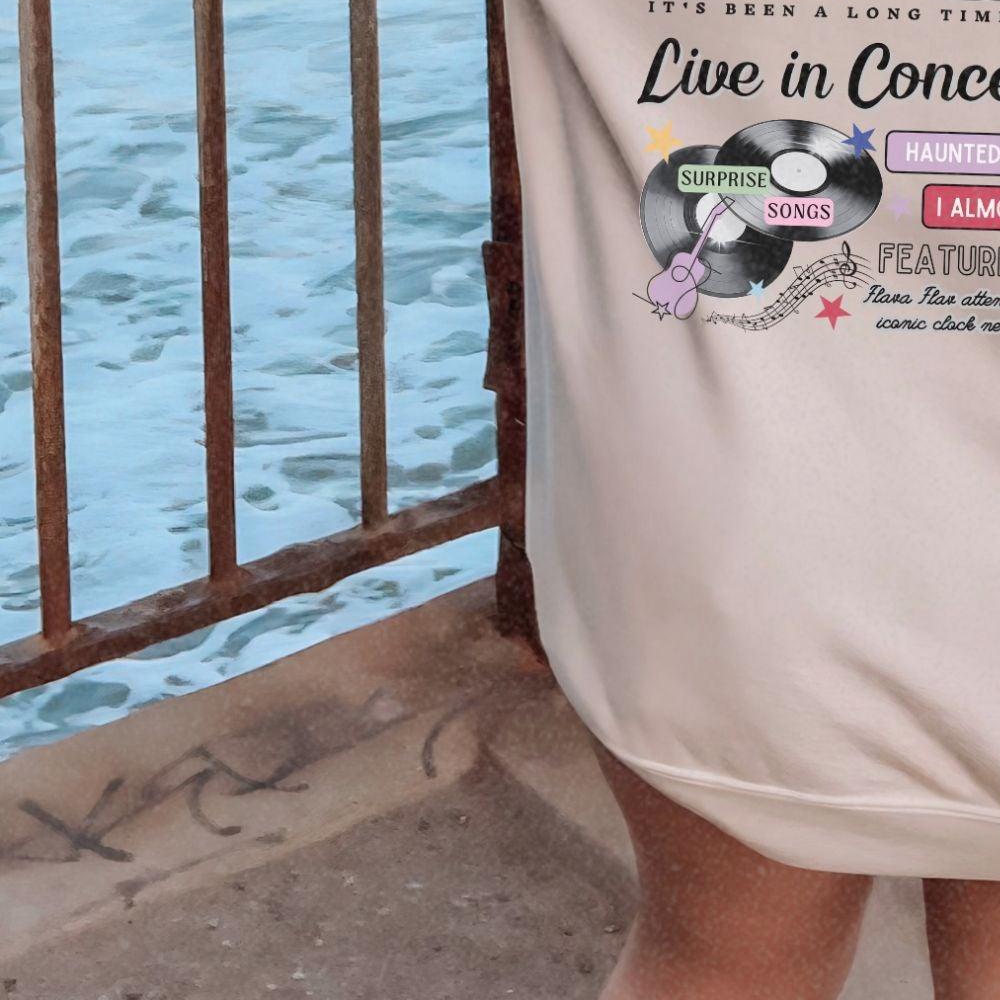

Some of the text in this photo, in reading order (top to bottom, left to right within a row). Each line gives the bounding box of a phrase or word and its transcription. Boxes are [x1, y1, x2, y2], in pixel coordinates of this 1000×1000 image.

[648, 1, 706, 15] IT'S
[726, 3, 797, 17] BEEN
[814, 6, 828, 18] A
[847, 6, 922, 21] LONG
[637, 37, 764, 104] Live
[780, 51, 834, 99] in
[681, 169, 768, 188] SURPRISE
[767, 203, 831, 220] SONGS
[936, 198, 942, 217] I
[863, 285, 912, 305] Flava
[917, 285, 956, 305] Flav
[876, 315, 927, 331] iconic
[932, 315, 976, 332] clock
